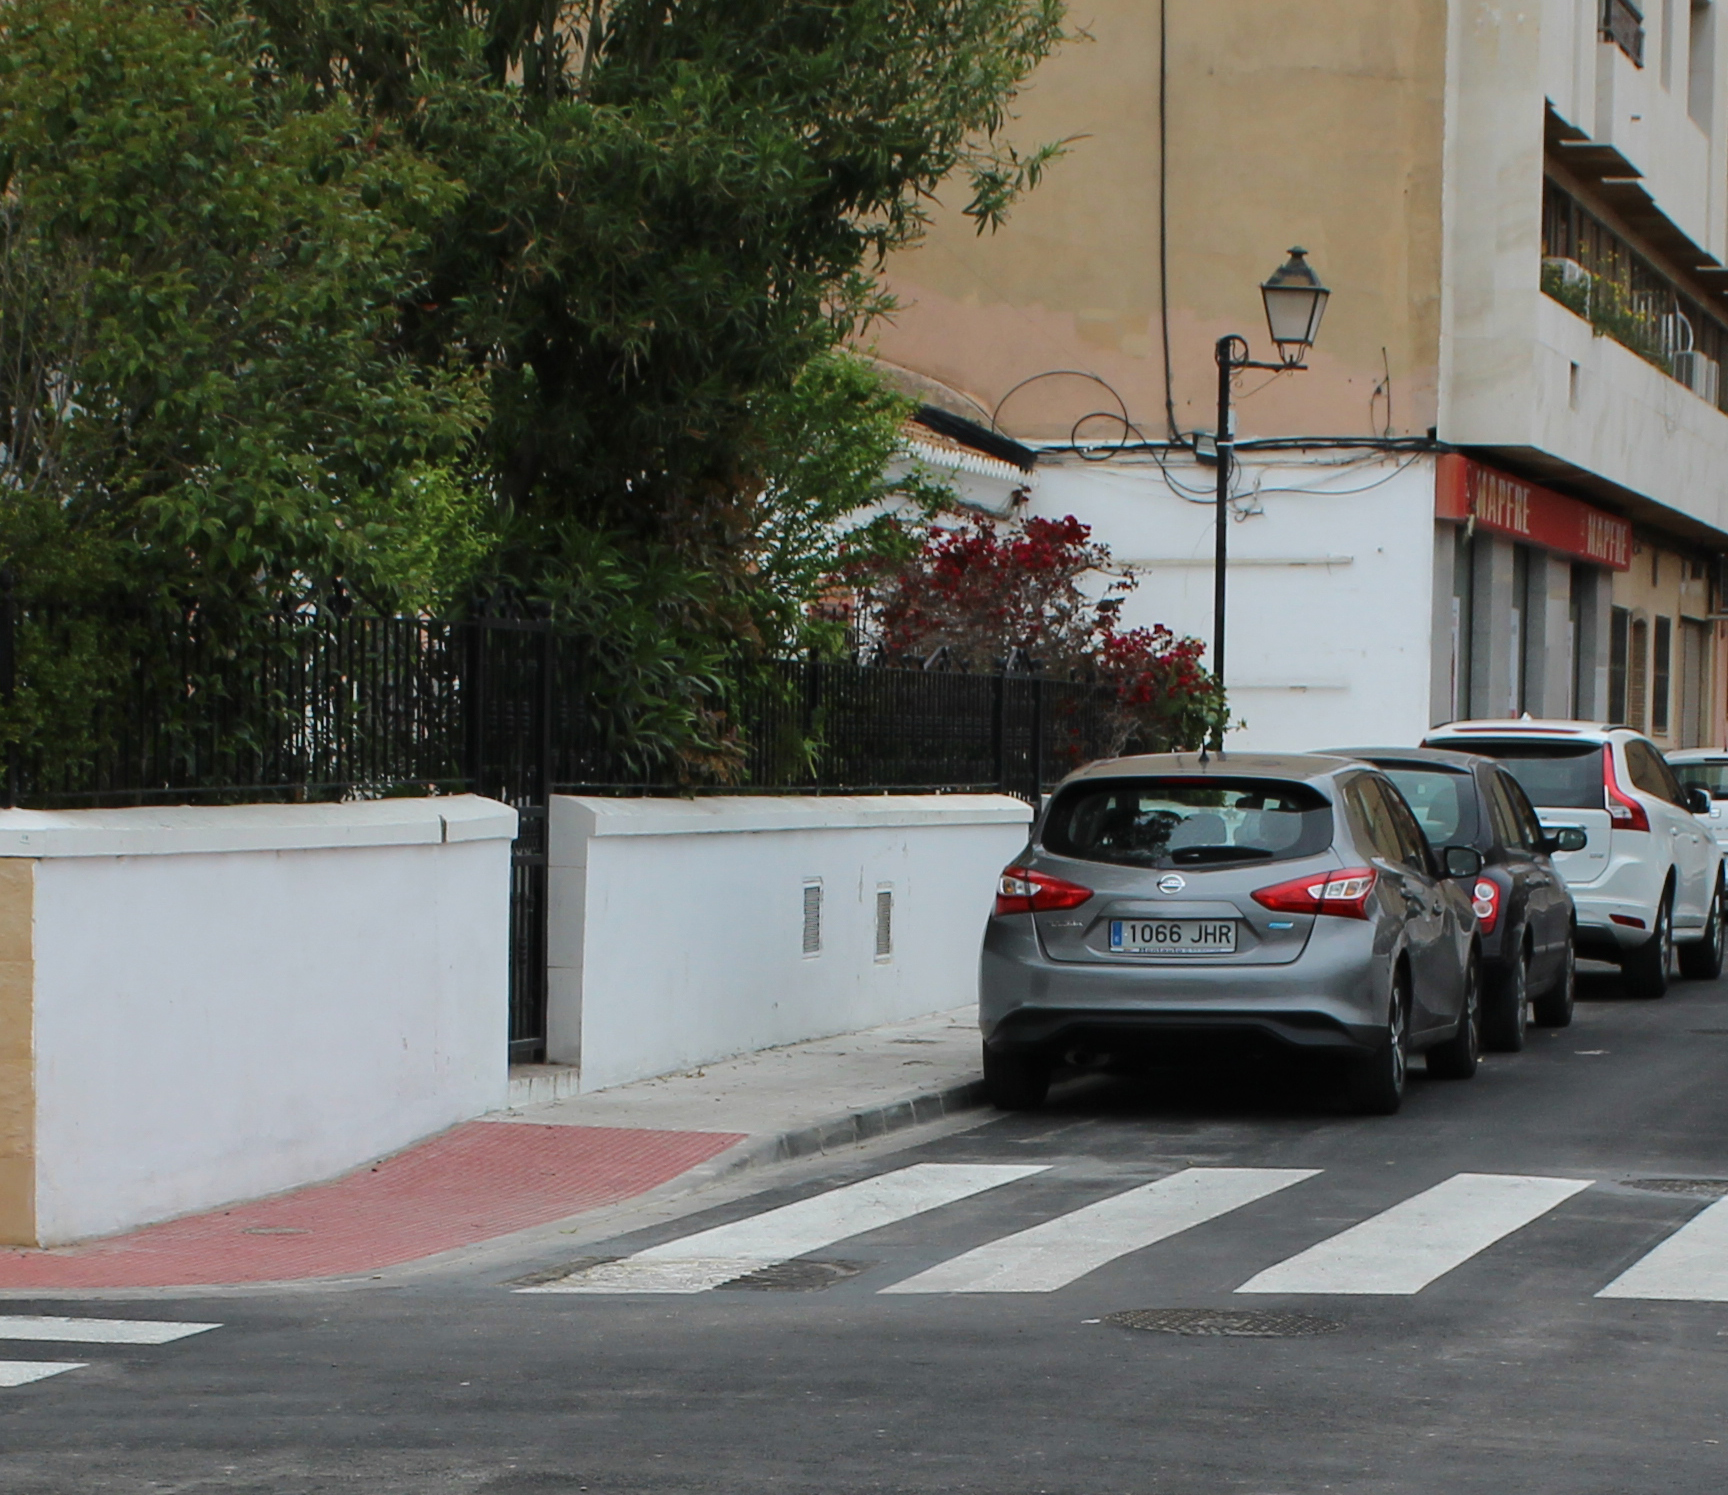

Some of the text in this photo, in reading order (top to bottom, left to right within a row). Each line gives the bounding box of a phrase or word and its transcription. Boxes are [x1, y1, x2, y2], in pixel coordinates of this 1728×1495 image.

[1476, 469, 1531, 535] MAPFRE
[1587, 512, 1627, 565] MAPFRE
[1130, 924, 1232, 944] 1066 JHR
